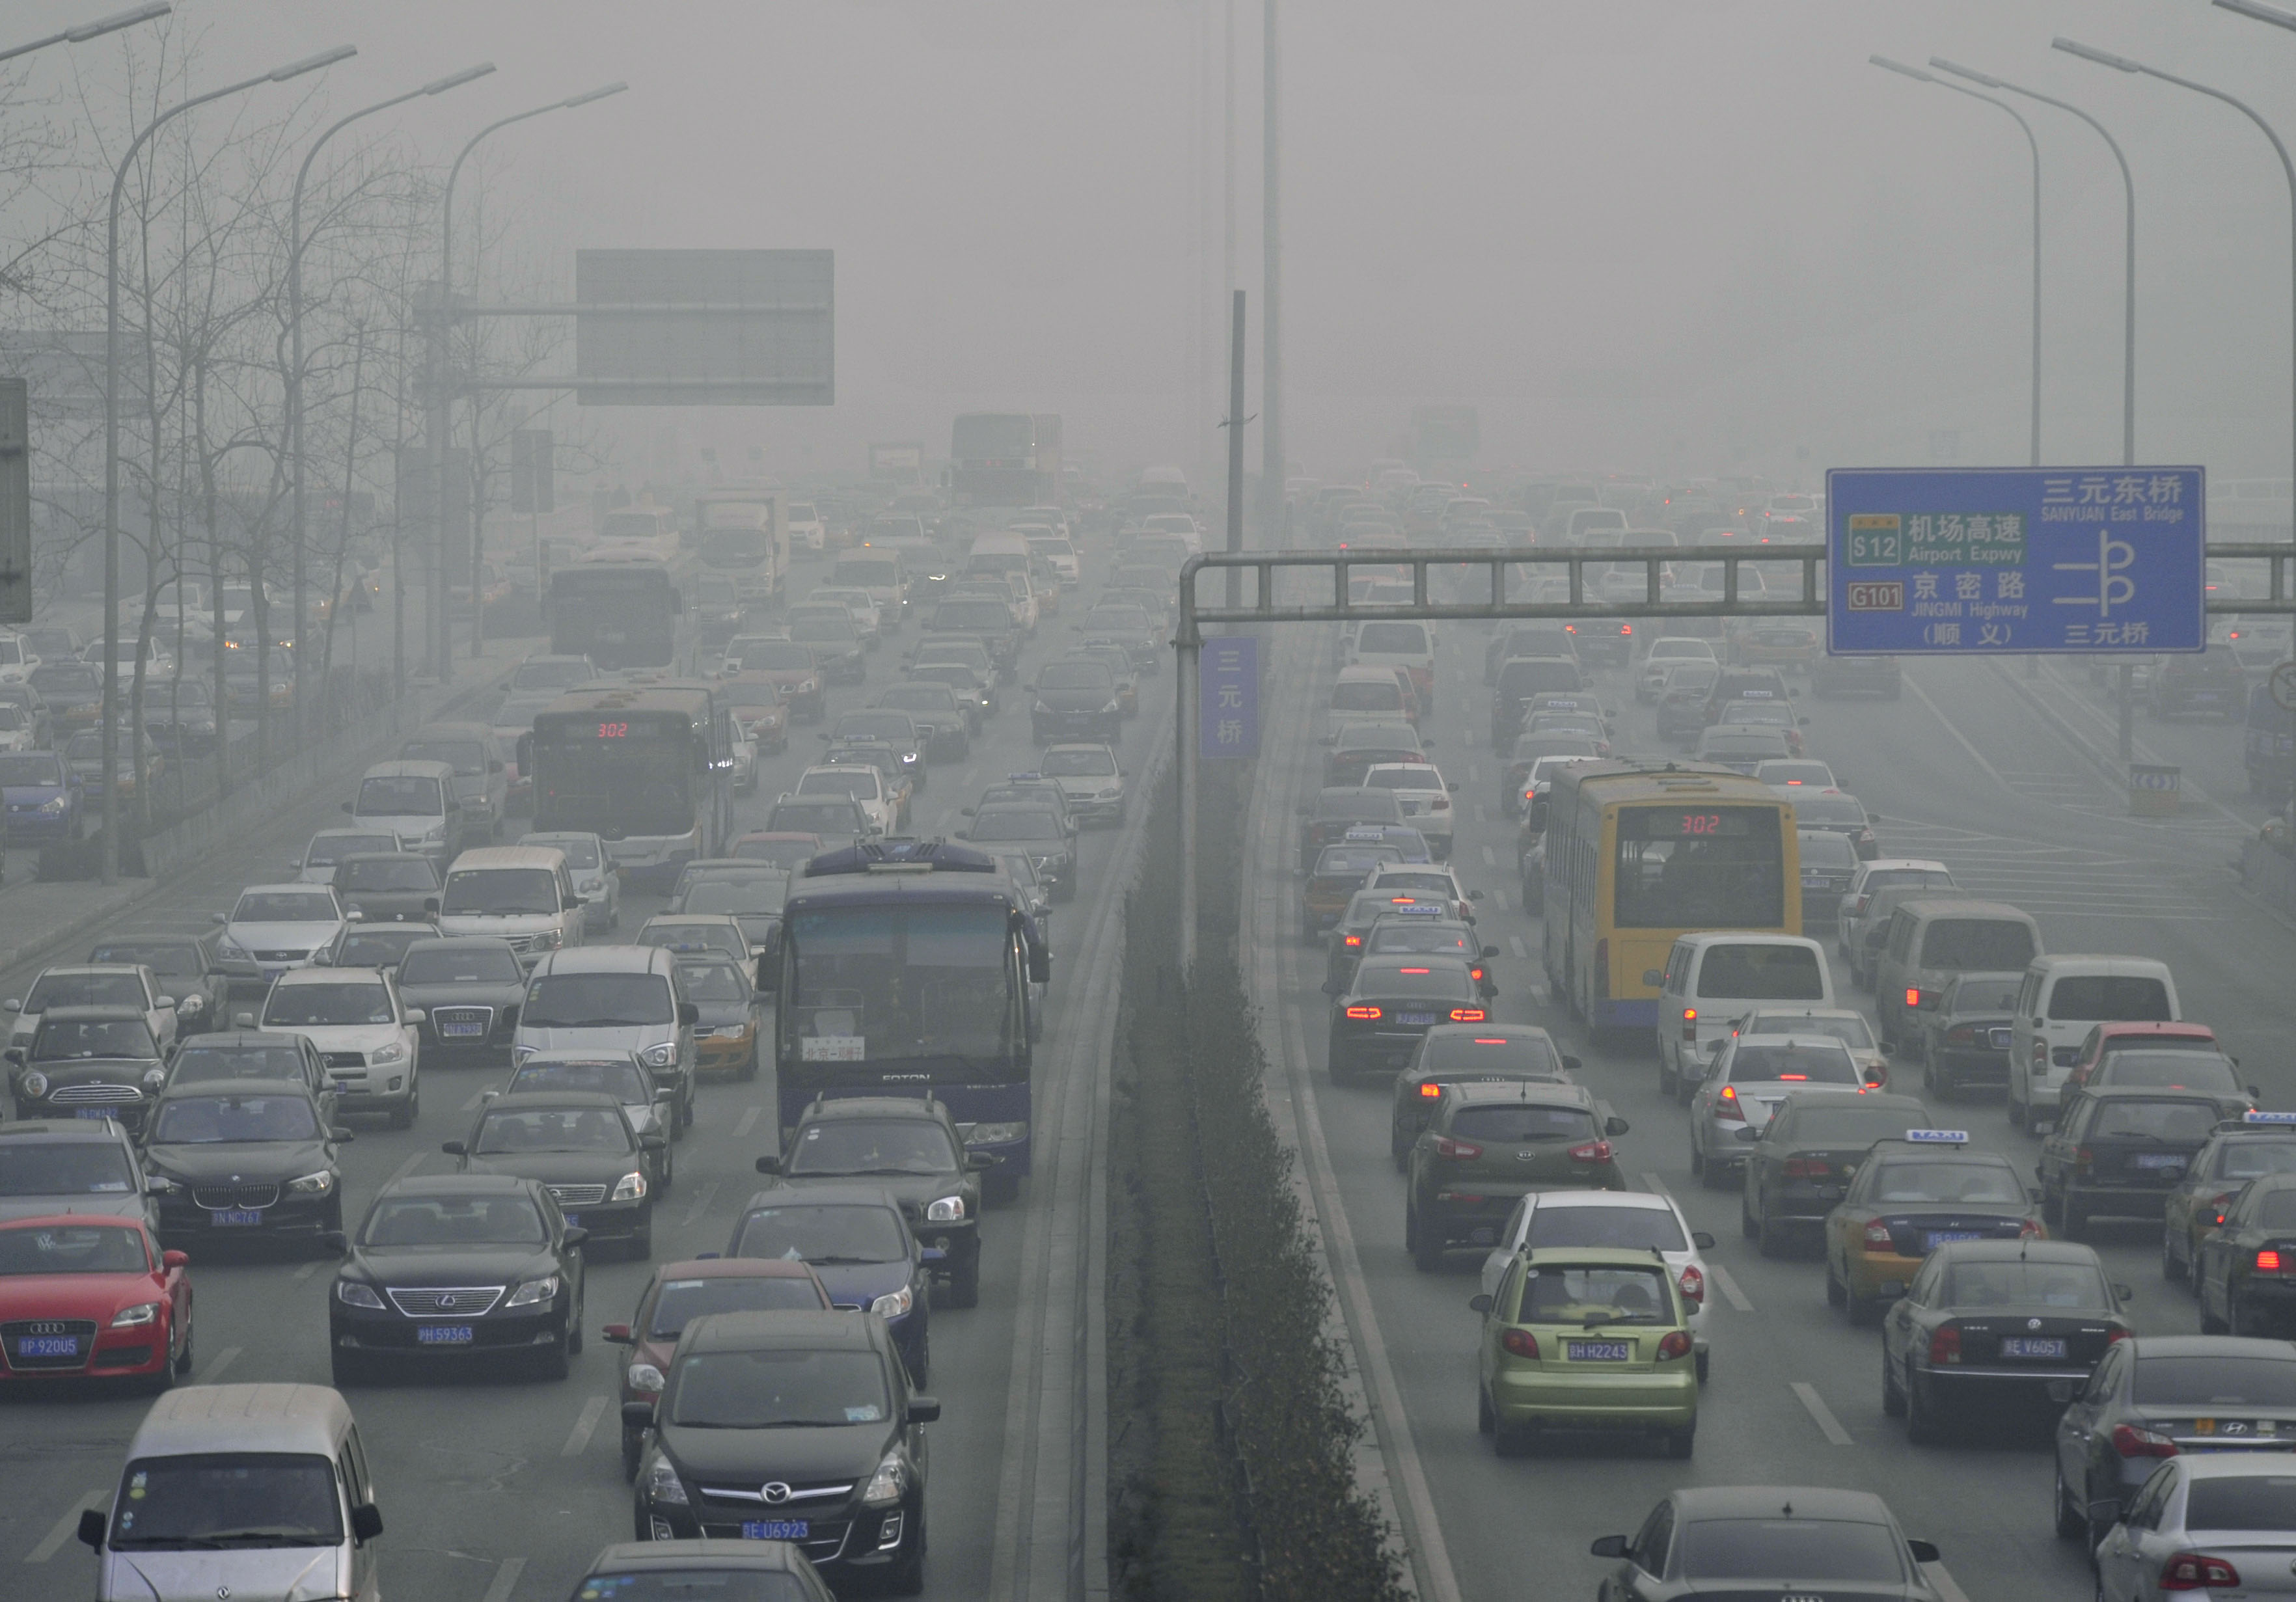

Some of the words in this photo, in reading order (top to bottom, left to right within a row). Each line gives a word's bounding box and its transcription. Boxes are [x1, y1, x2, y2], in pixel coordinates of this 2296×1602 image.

[2042, 476, 2182, 504] 三元东桥
[2041, 506, 2105, 521] SANYUAN
[2111, 506, 2137, 521] East
[2143, 505, 2184, 524] Bridge
[1909, 514, 2021, 543] 机场高速
[1853, 536, 1896, 558] S12
[1909, 546, 1962, 564] Airport
[1970, 546, 2022, 564] Expwy
[1852, 587, 1899, 606] G101
[1912, 601, 1962, 617] JINGMI
[1969, 601, 2029, 620] Highway
[2064, 621, 2150, 645] 三元桥
[1217, 651, 1243, 744] 三元桥
[598, 723, 628, 737] 302
[1681, 815, 1719, 834] 302
